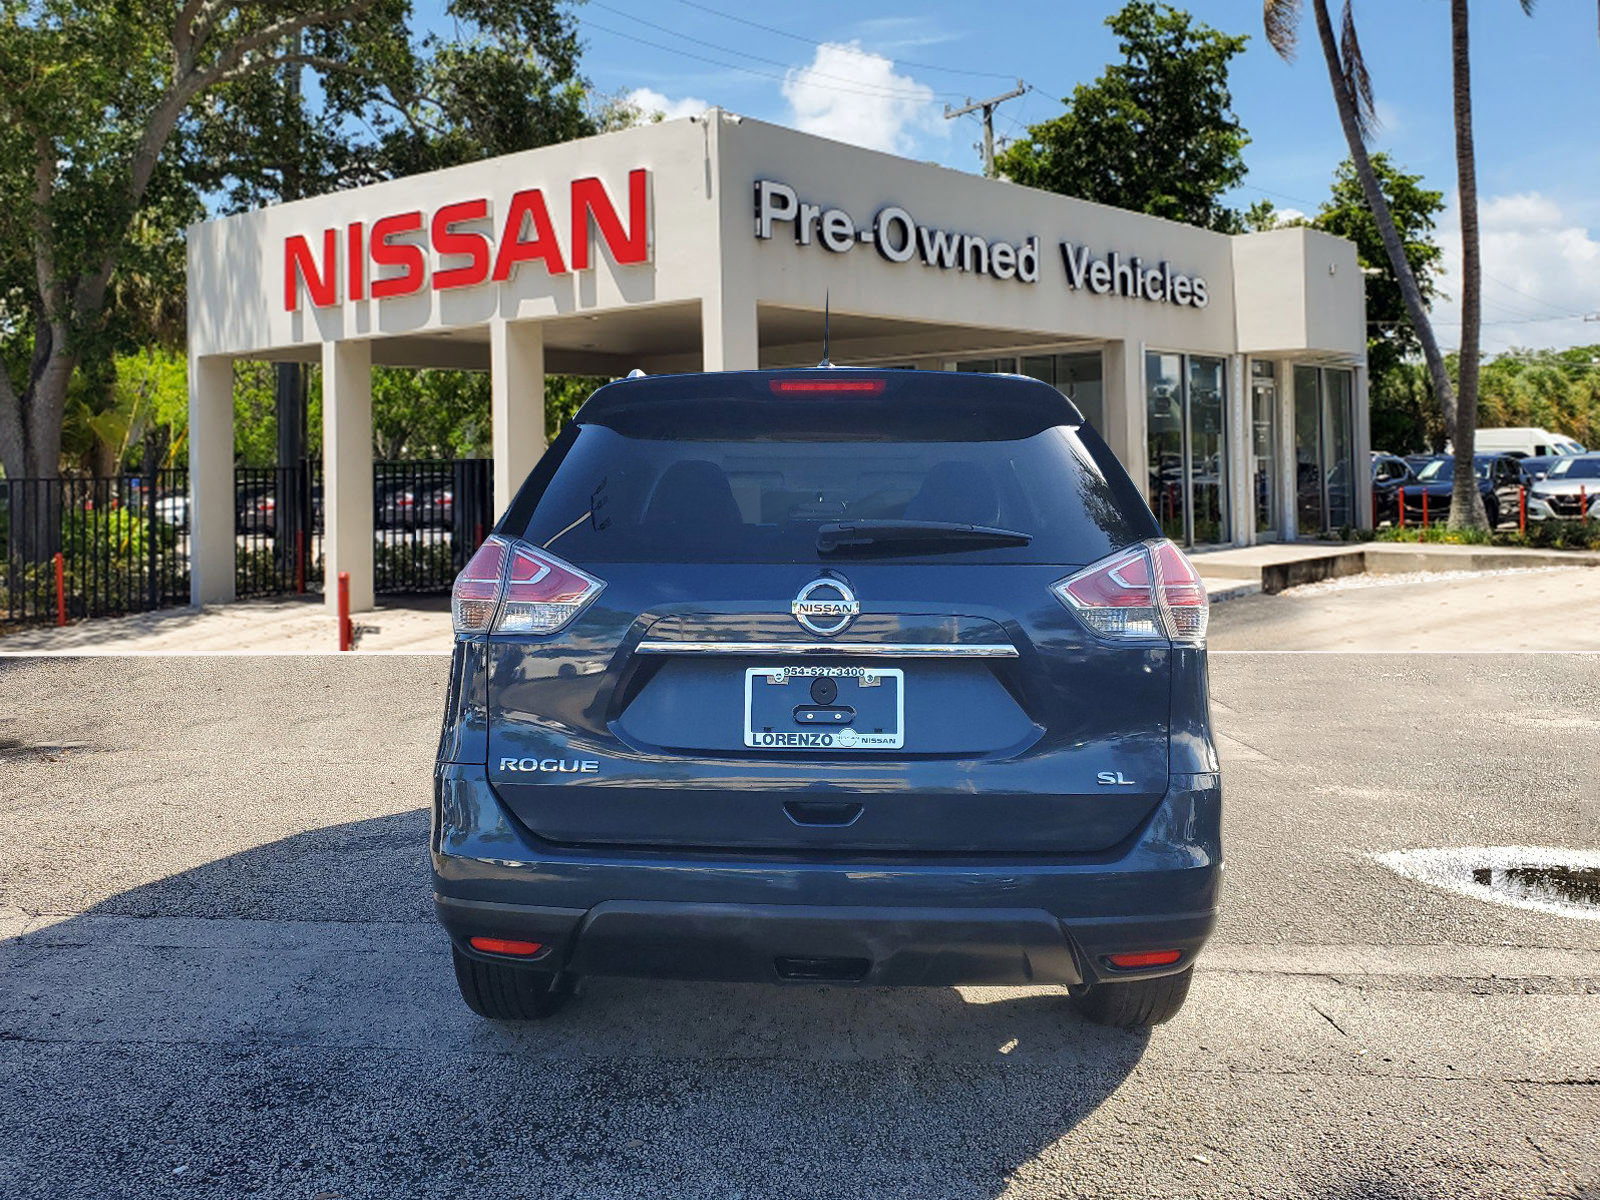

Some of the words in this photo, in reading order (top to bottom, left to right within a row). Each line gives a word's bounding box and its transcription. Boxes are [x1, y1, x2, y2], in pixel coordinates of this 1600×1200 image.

[285, 168, 648, 312] NISSAN
[754, 179, 1041, 284] Pre-Owned
[1060, 241, 1209, 309] Vehicles
[799, 603, 852, 613] NISSAN
[783, 666, 865, 677] 954-527-3400
[752, 733, 834, 747] LORENZO
[861, 737, 896, 745] NISSAN
[499, 757, 600, 773] ROGUE
[1097, 771, 1136, 785] SL
